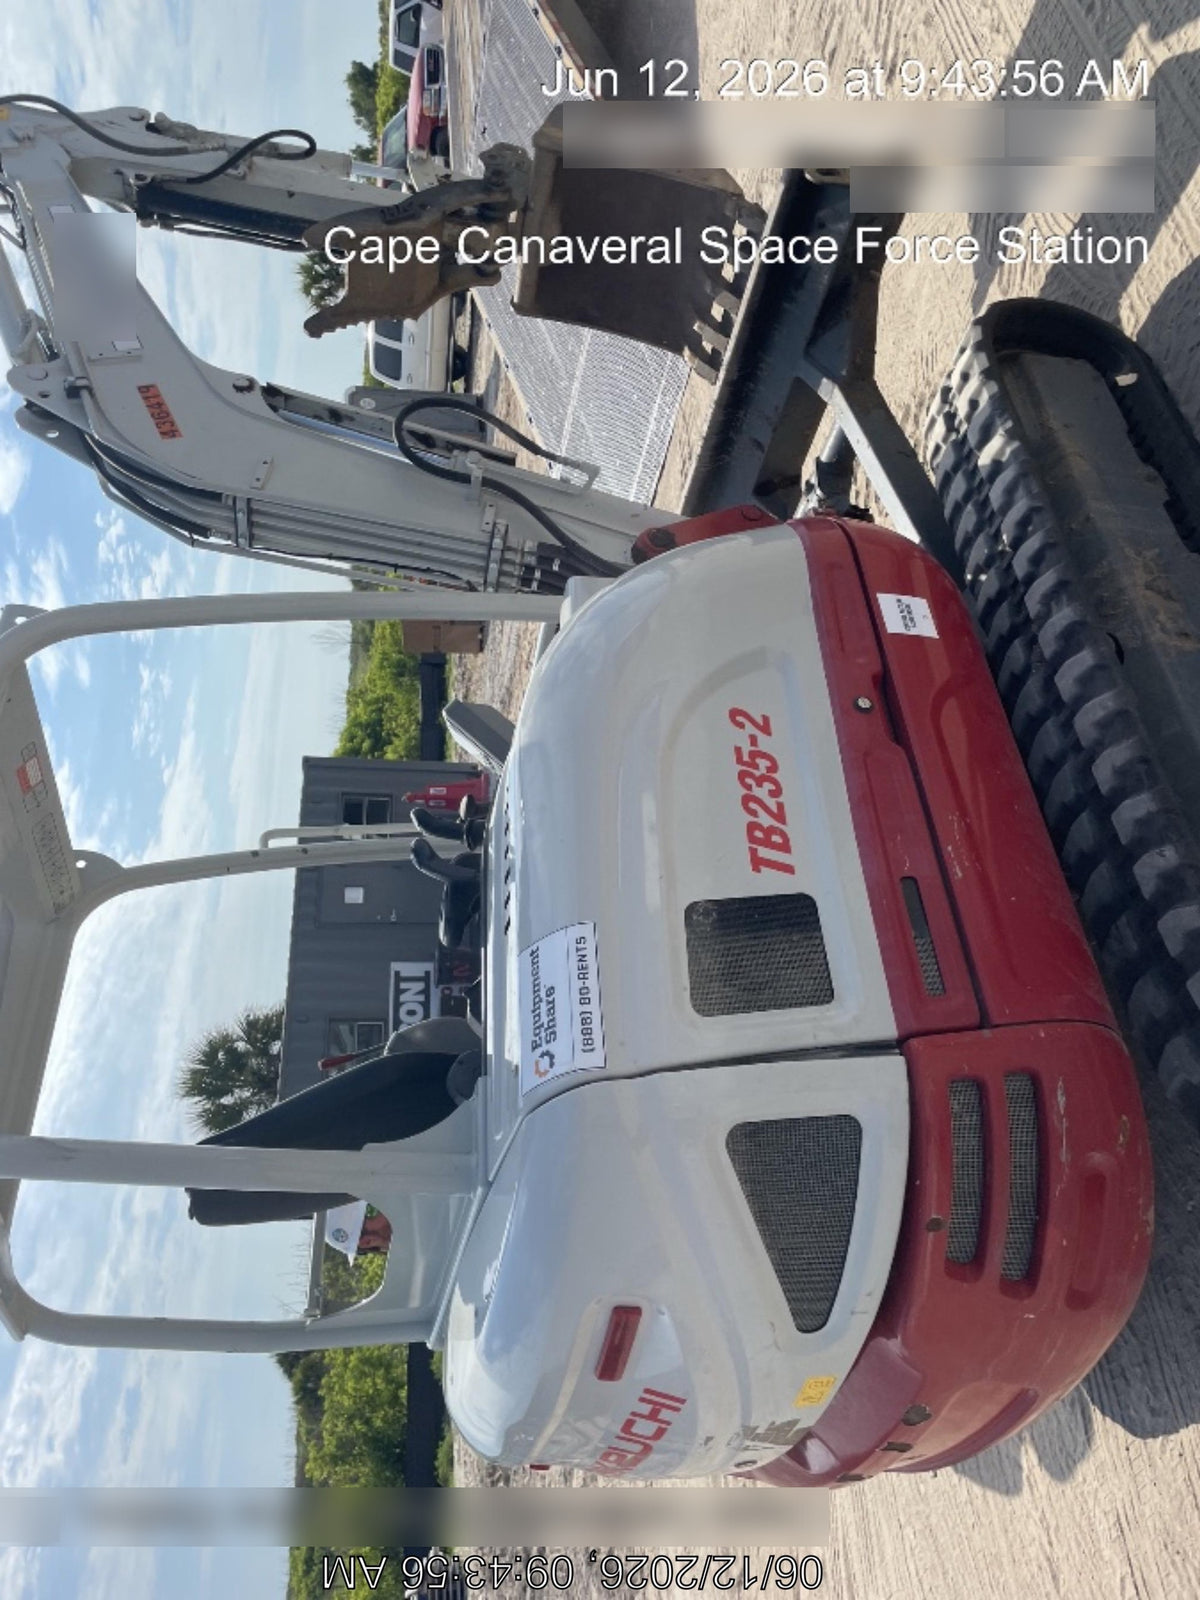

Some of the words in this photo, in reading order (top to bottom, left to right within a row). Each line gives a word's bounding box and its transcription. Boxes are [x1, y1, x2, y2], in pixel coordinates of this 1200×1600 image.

[728, 707, 796, 876] TB235-2
[529, 946, 545, 1053] Equipment
[543, 985, 557, 1044] Share
[579, 1010, 596, 1054] (888)
